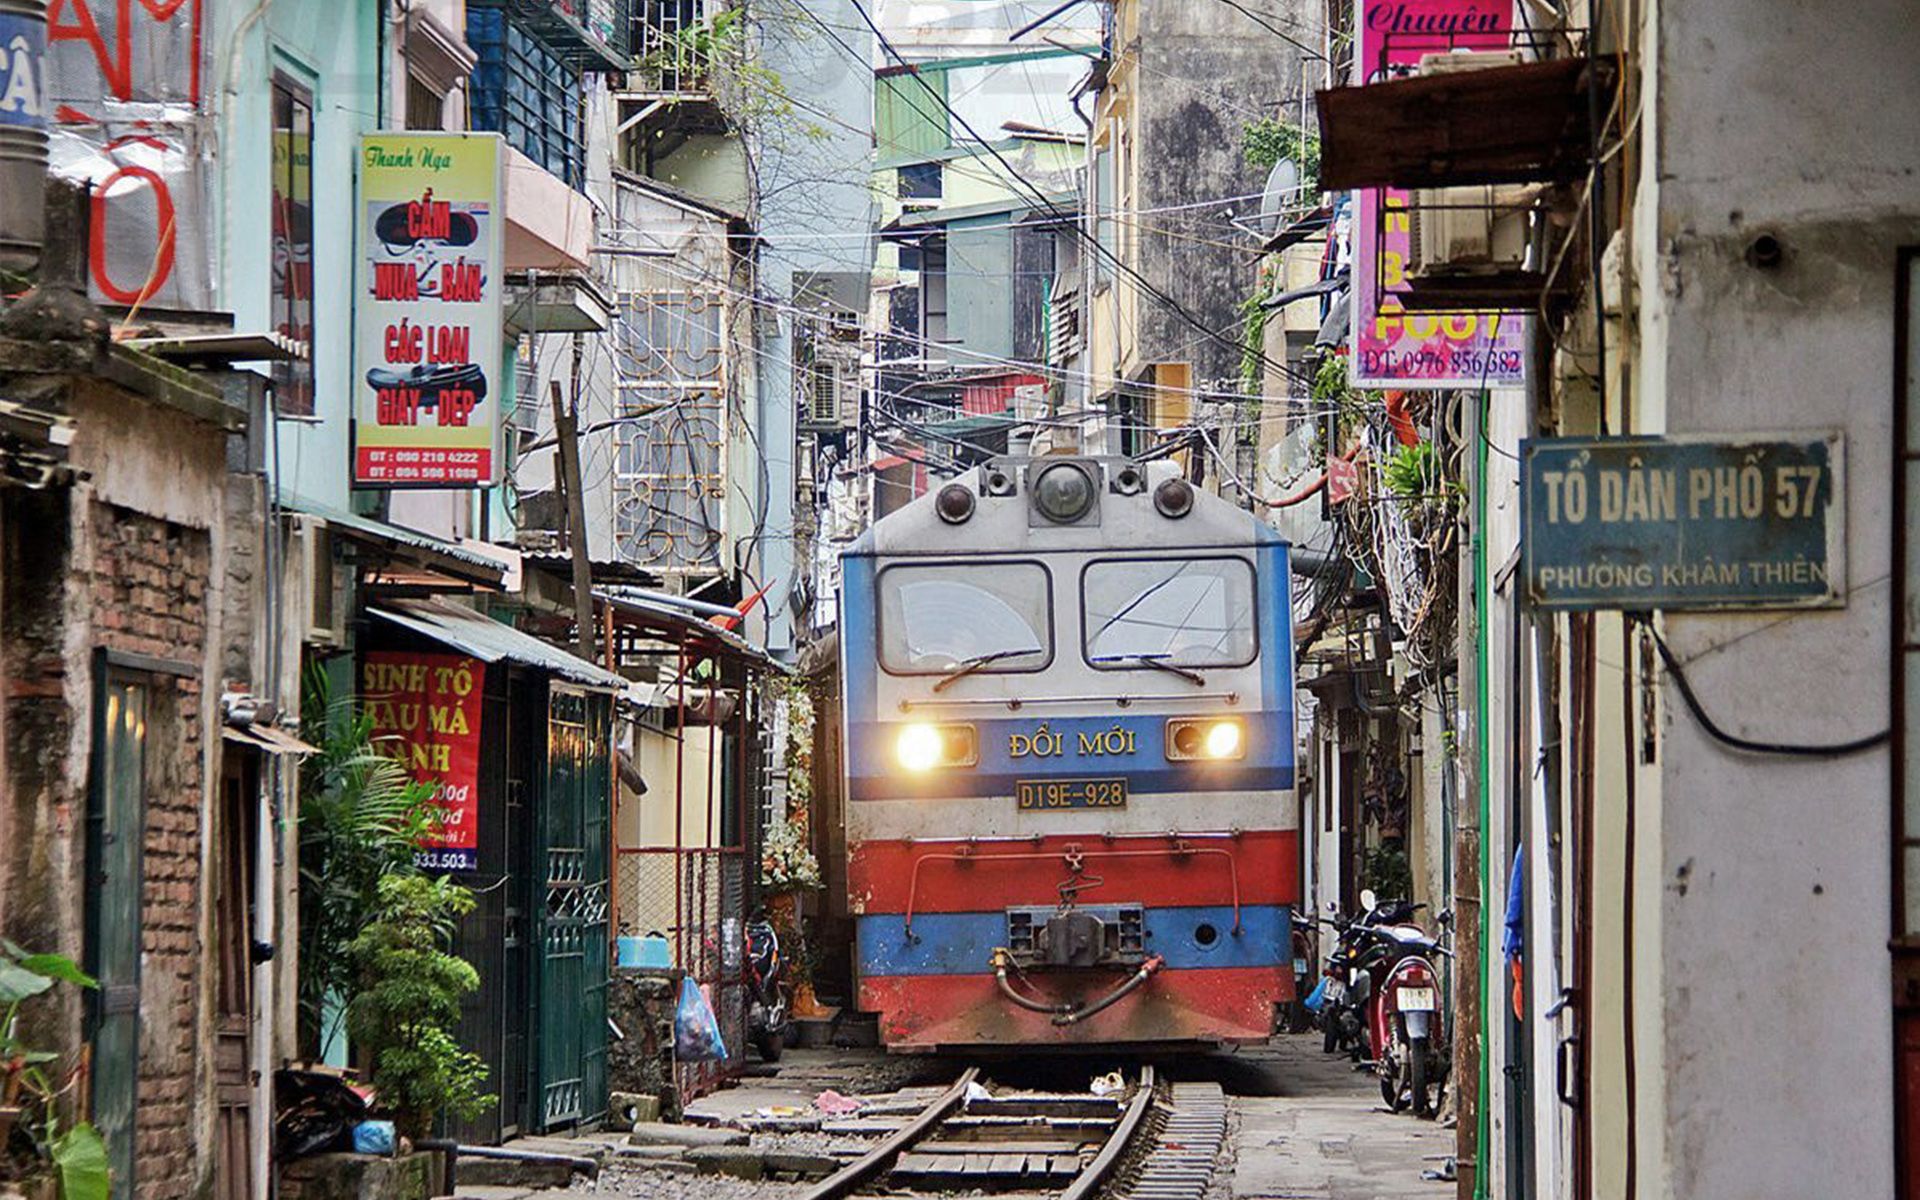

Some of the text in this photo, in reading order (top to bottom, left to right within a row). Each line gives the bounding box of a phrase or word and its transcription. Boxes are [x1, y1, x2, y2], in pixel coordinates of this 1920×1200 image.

[1367, 3, 1499, 37] Chuyên
[366, 146, 452, 172] Thanh Nga
[375, 263, 419, 301] MUA
[441, 256, 481, 302] BÁN
[385, 317, 423, 364] CÁC
[1403, 352, 1446, 375] 0976
[1451, 352, 1483, 375] 856
[1487, 351, 1521, 374] 382
[437, 382, 476, 428] DÉP
[1543, 449, 1822, 524] TỔ DÂN PHỐ 57
[1540, 553, 1828, 590] PHƯỜNG KHÂM THIÊN
[363, 658, 474, 697] SINH TỐ
[427, 700, 470, 735] MÁ
[1009, 721, 1137, 758] ĐỔI MỚI
[1021, 782, 1123, 808] D19E-928
